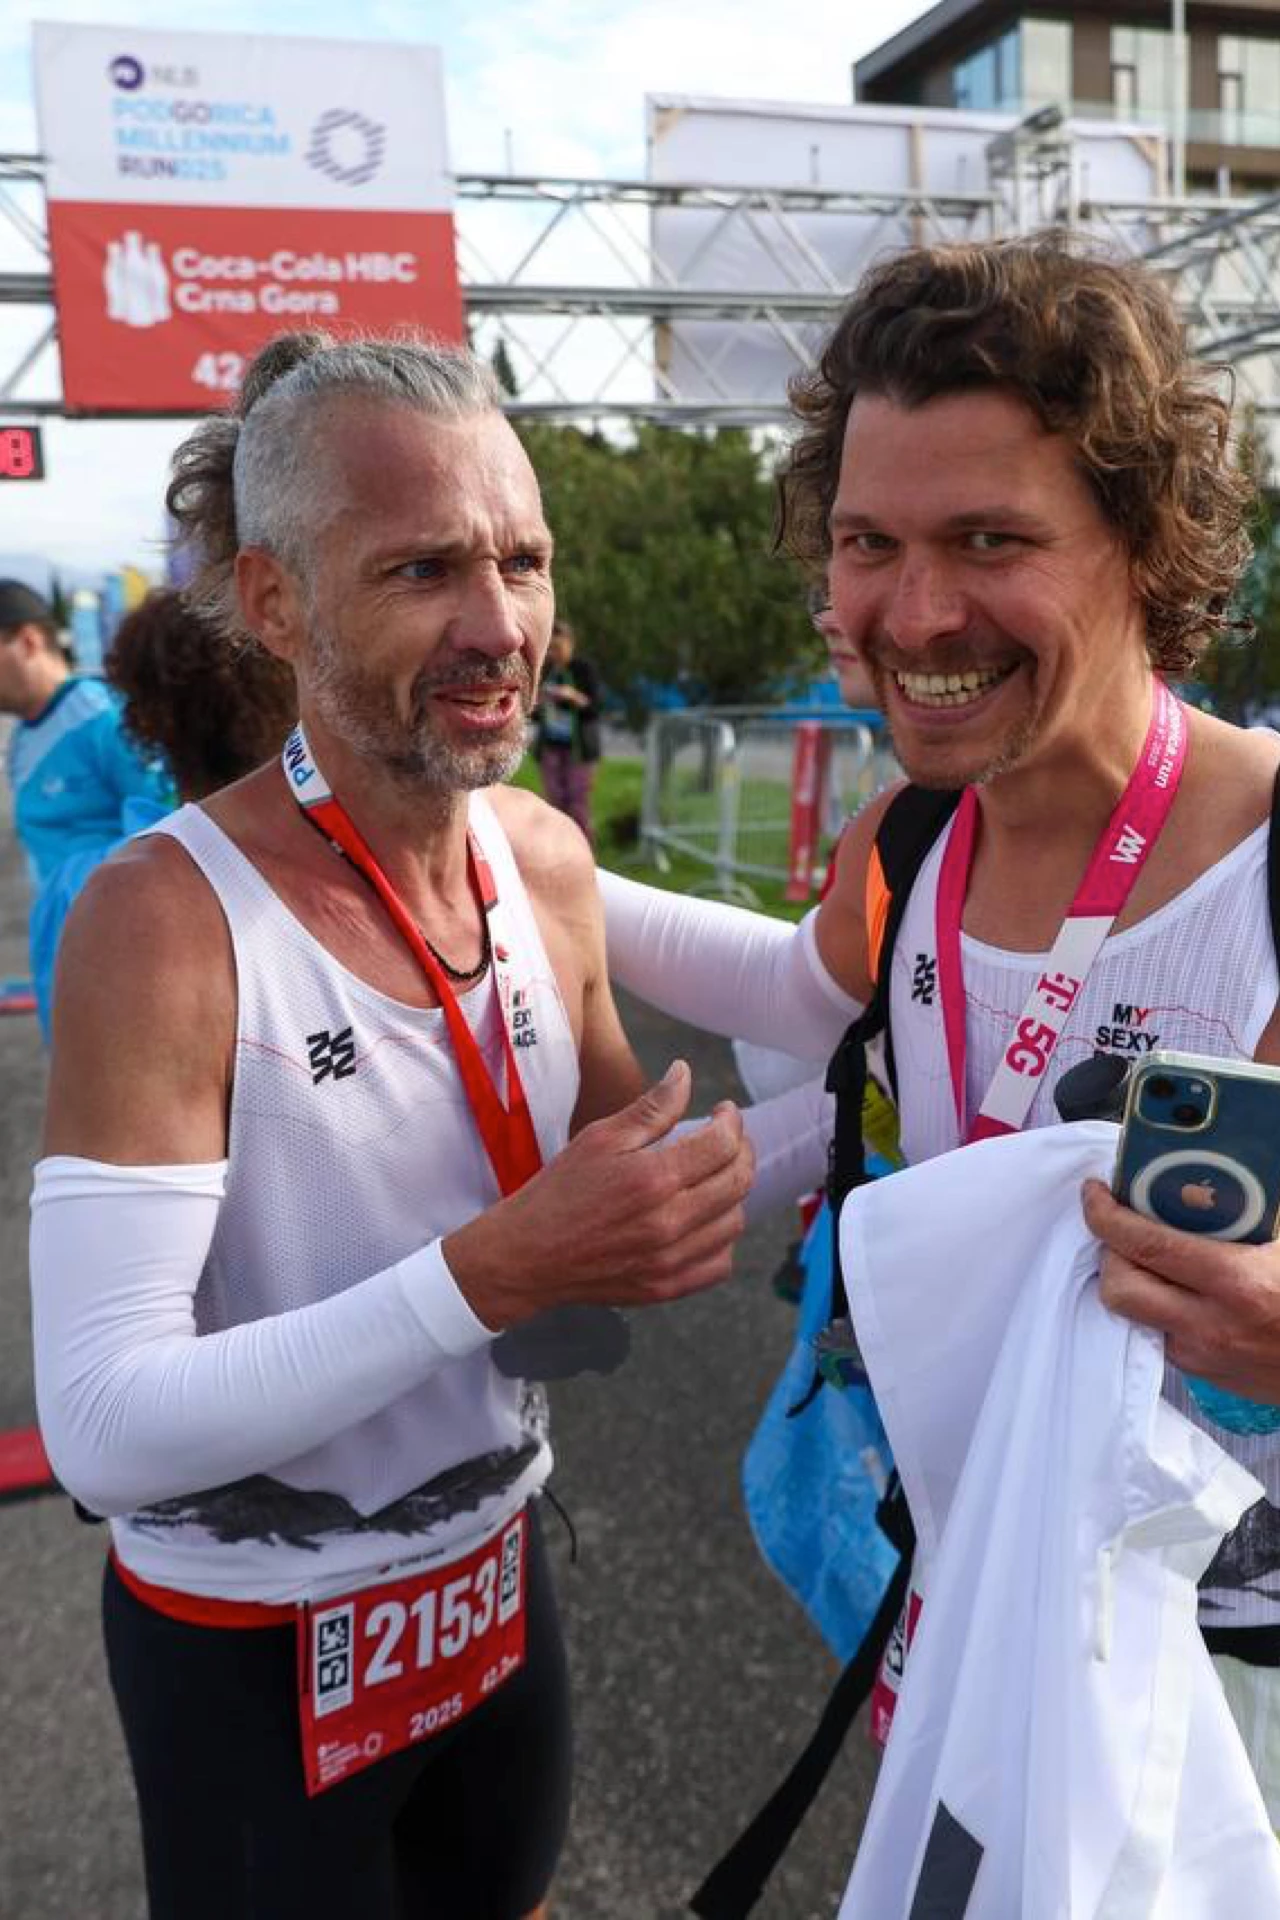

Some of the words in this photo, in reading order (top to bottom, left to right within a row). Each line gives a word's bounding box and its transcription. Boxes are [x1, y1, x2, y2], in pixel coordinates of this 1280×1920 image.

[113, 97, 275, 125] PODGORICA
[116, 127, 292, 155] MILLENNIUM
[172, 247, 342, 282] Coca-Cola
[346, 252, 418, 284] HBC
[174, 282, 256, 314] Crna
[258, 284, 340, 315] Gora
[1112, 1003, 1149, 1027] MY
[1005, 1017, 1057, 1077] 5G
[1095, 1026, 1160, 1052] SEXY
[363, 1556, 499, 1688] 2153
[410, 1692, 463, 1739] 2025
